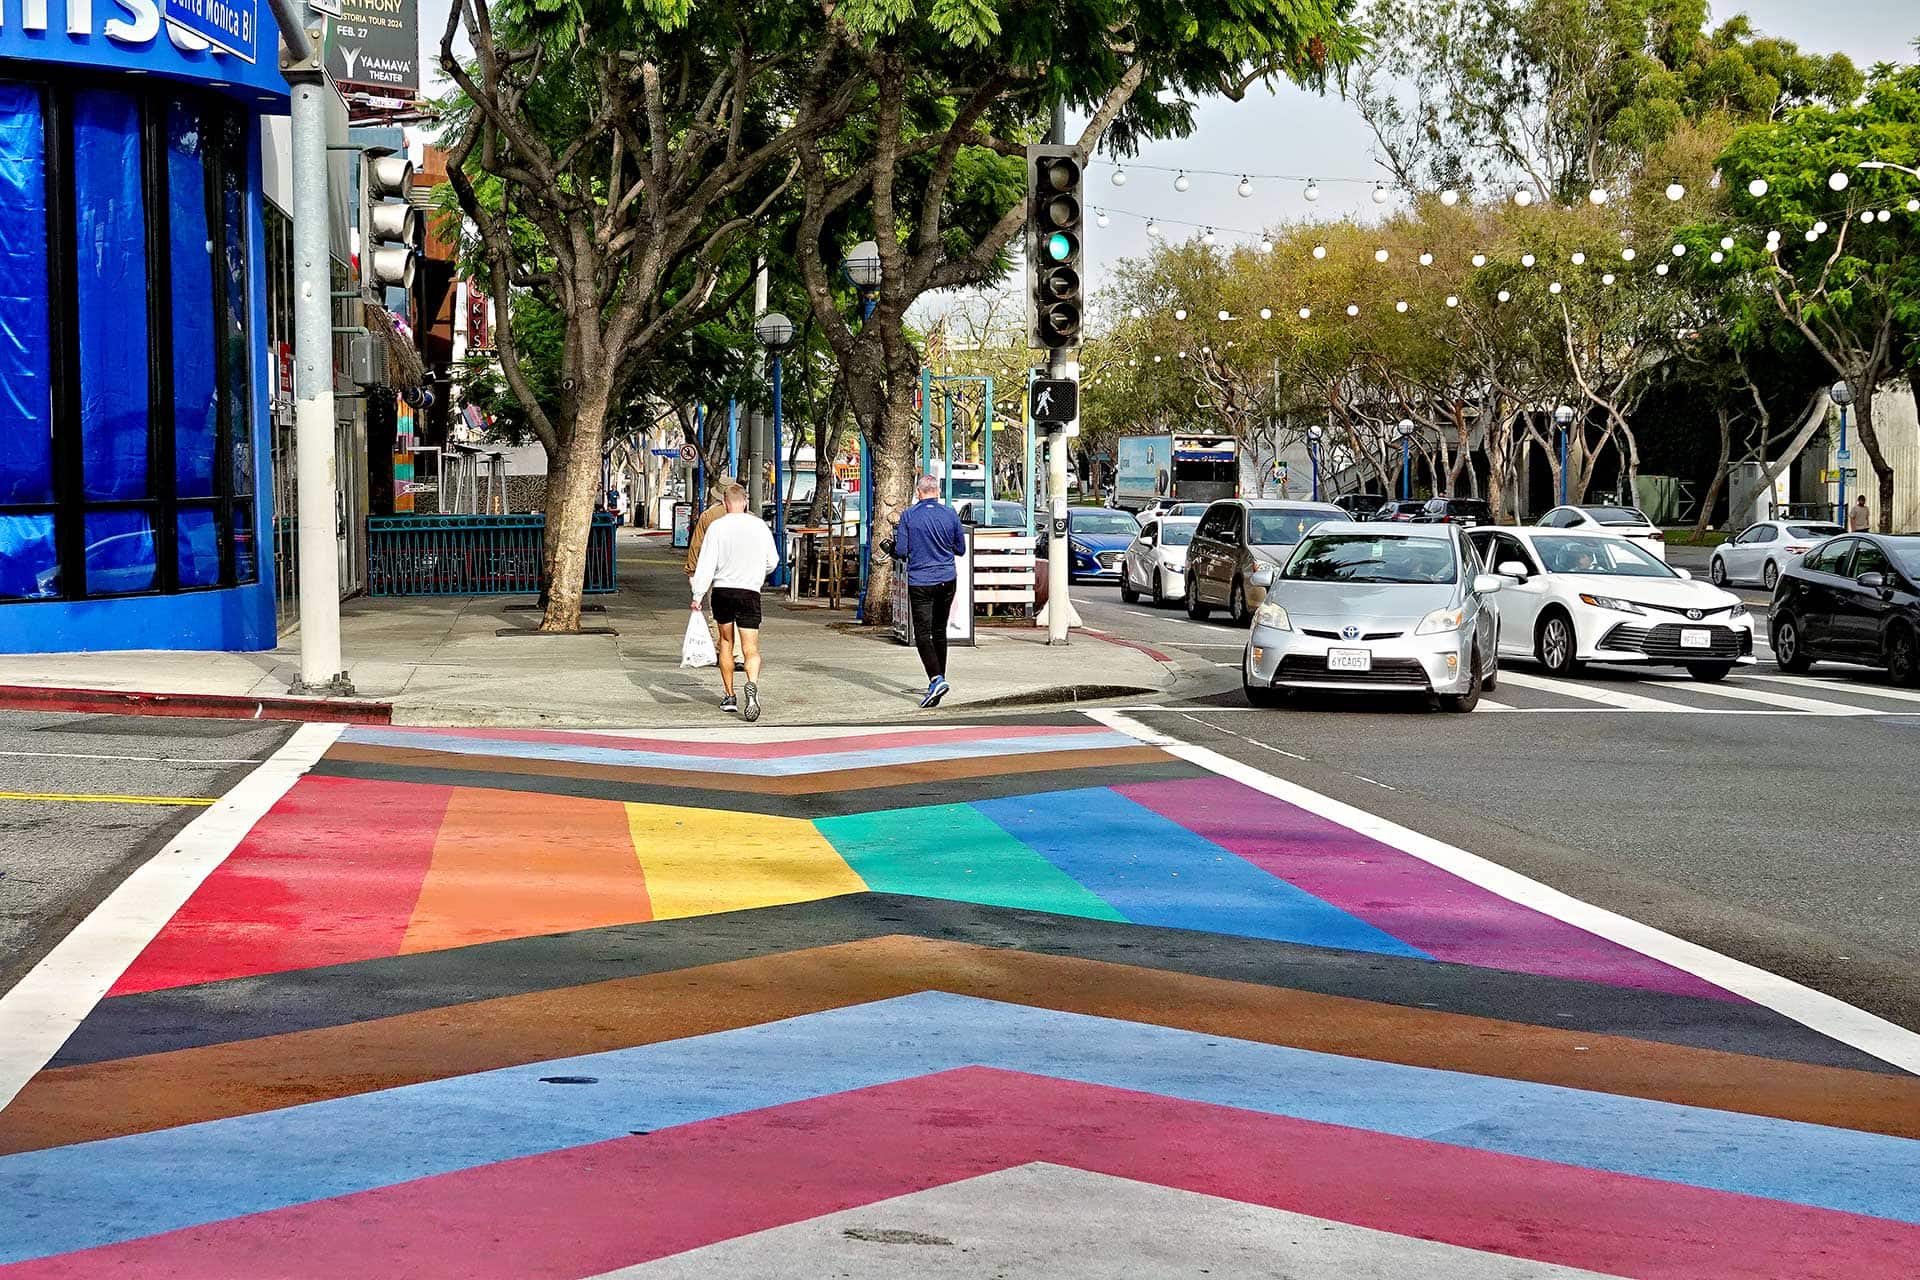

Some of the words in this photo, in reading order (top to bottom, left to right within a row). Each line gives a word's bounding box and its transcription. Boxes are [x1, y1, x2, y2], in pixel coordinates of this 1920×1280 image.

[205, 0, 239, 37] Monica
[369, 16, 386, 26] TOUR
[387, 19, 403, 28] 2024
[337, 25, 356, 37] FEB.
[358, 28, 368, 38] 27
[369, 70, 403, 82] THEATER
